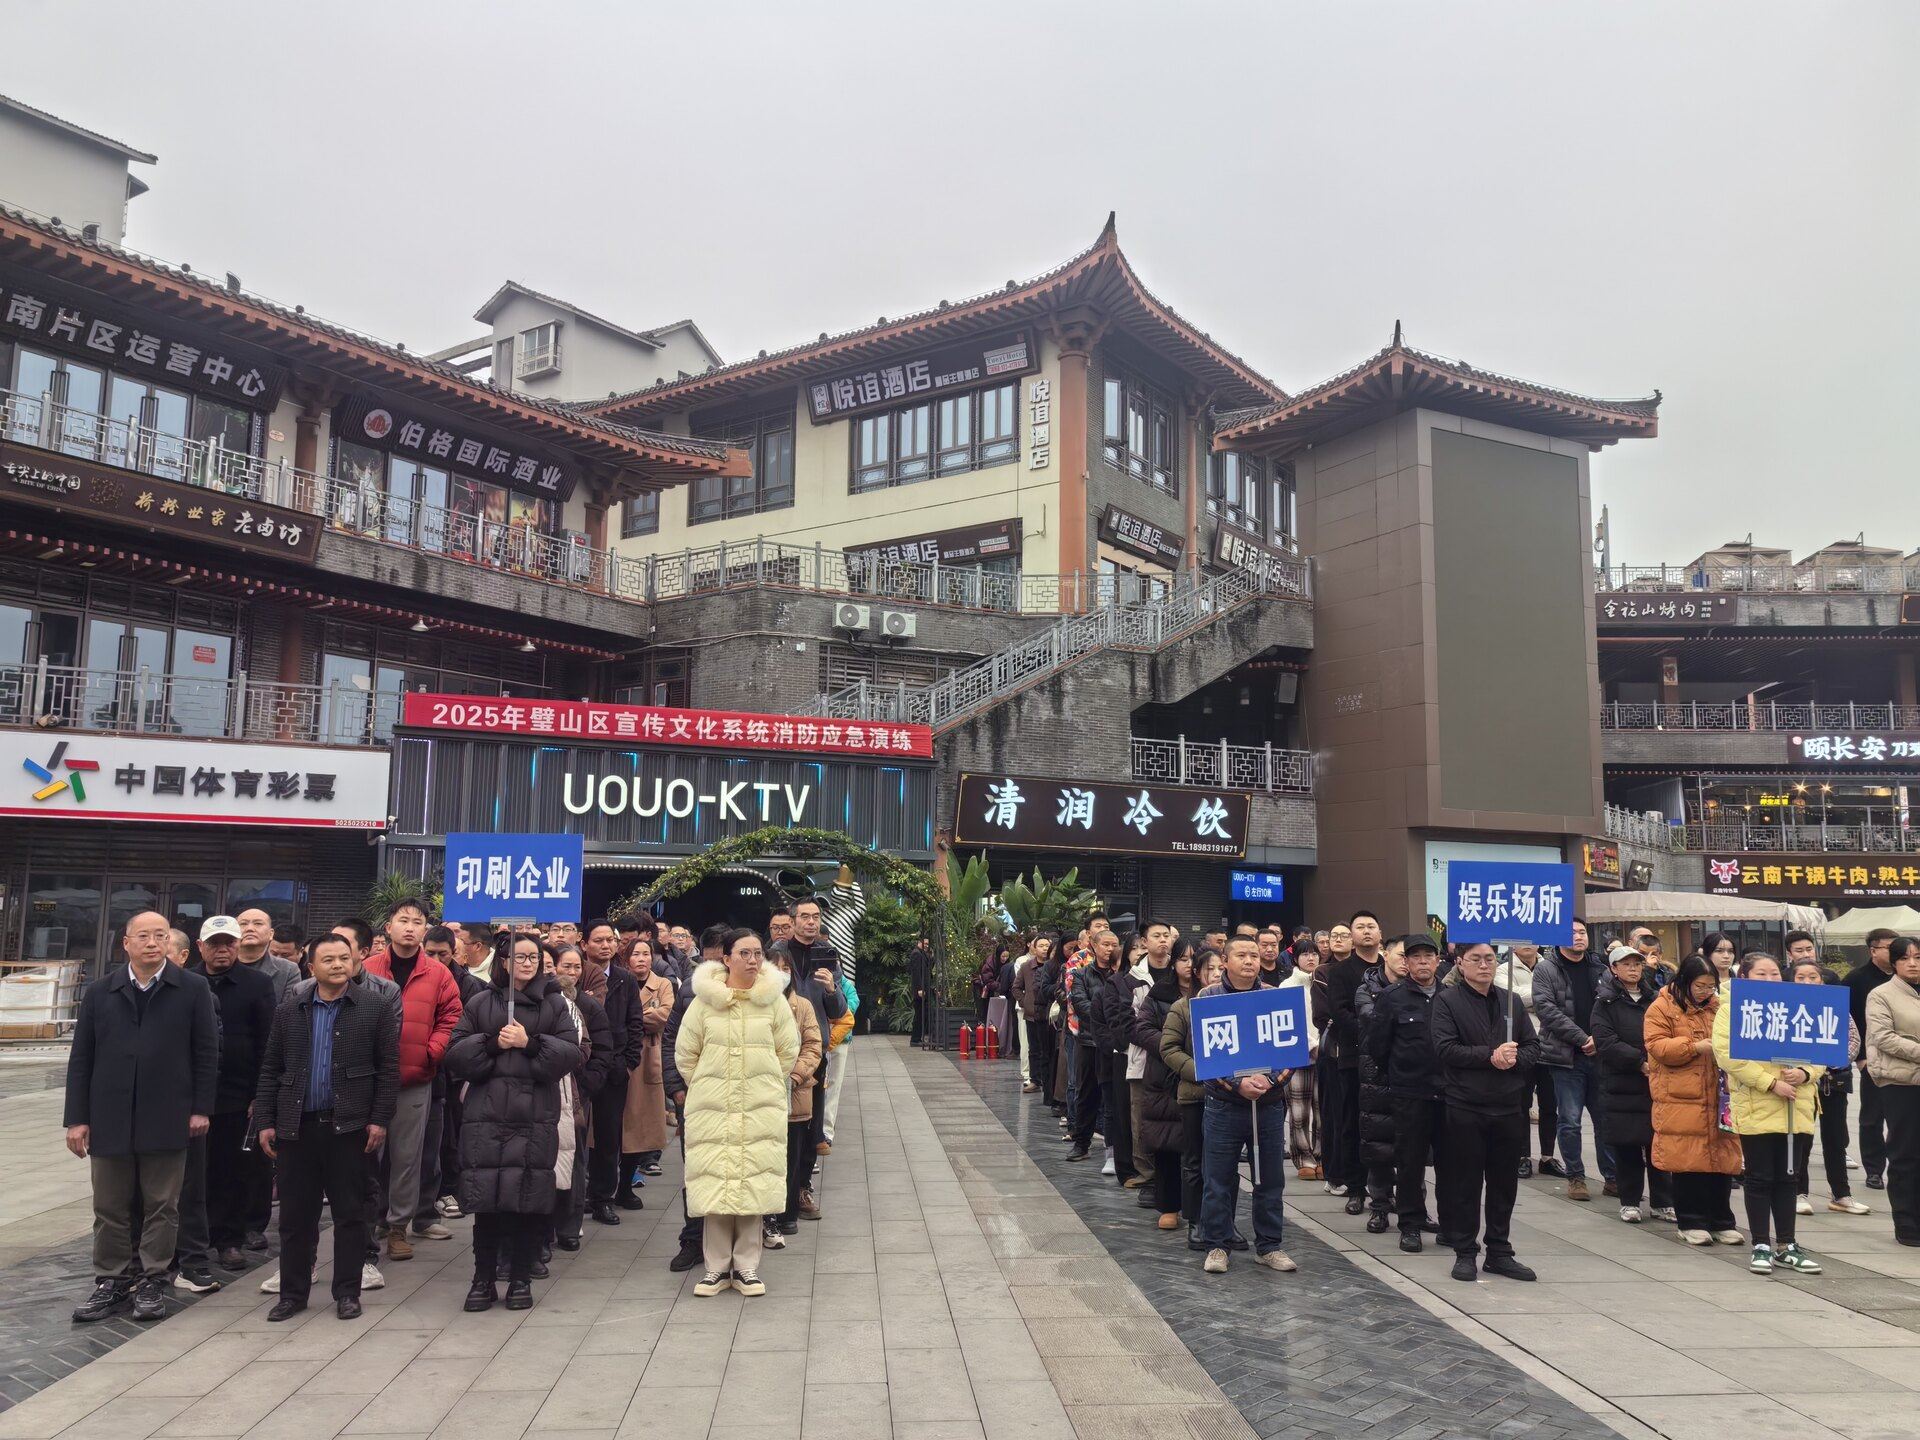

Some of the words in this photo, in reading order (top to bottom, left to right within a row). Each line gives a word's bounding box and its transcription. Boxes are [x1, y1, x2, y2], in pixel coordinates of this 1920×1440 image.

[0, 288, 266, 398] 南片区运营中心
[831, 360, 932, 410] 悦谊酒店
[1029, 379, 1050, 470] 悦谊酒店
[2, 462, 81, 490] 舌尖上的中国
[398, 420, 562, 491] 伯格国际酒业
[1118, 513, 1162, 548] 悦谊酒店
[432, 703, 912, 750] 2025年璧山区宣传文化系统消防应急演练
[115, 763, 337, 801] 中国体育彩票
[563, 773, 810, 823] UOUO-KTV
[983, 778, 1232, 839] 清润冷饮
[1171, 841, 1238, 853] TEL:18983191671
[456, 856, 570, 900] 印刷企业
[1458, 882, 1563, 925] 娱乐场所
[1200, 1008, 1299, 1058] 网吧
[1740, 999, 1839, 1045] 旅游企业
